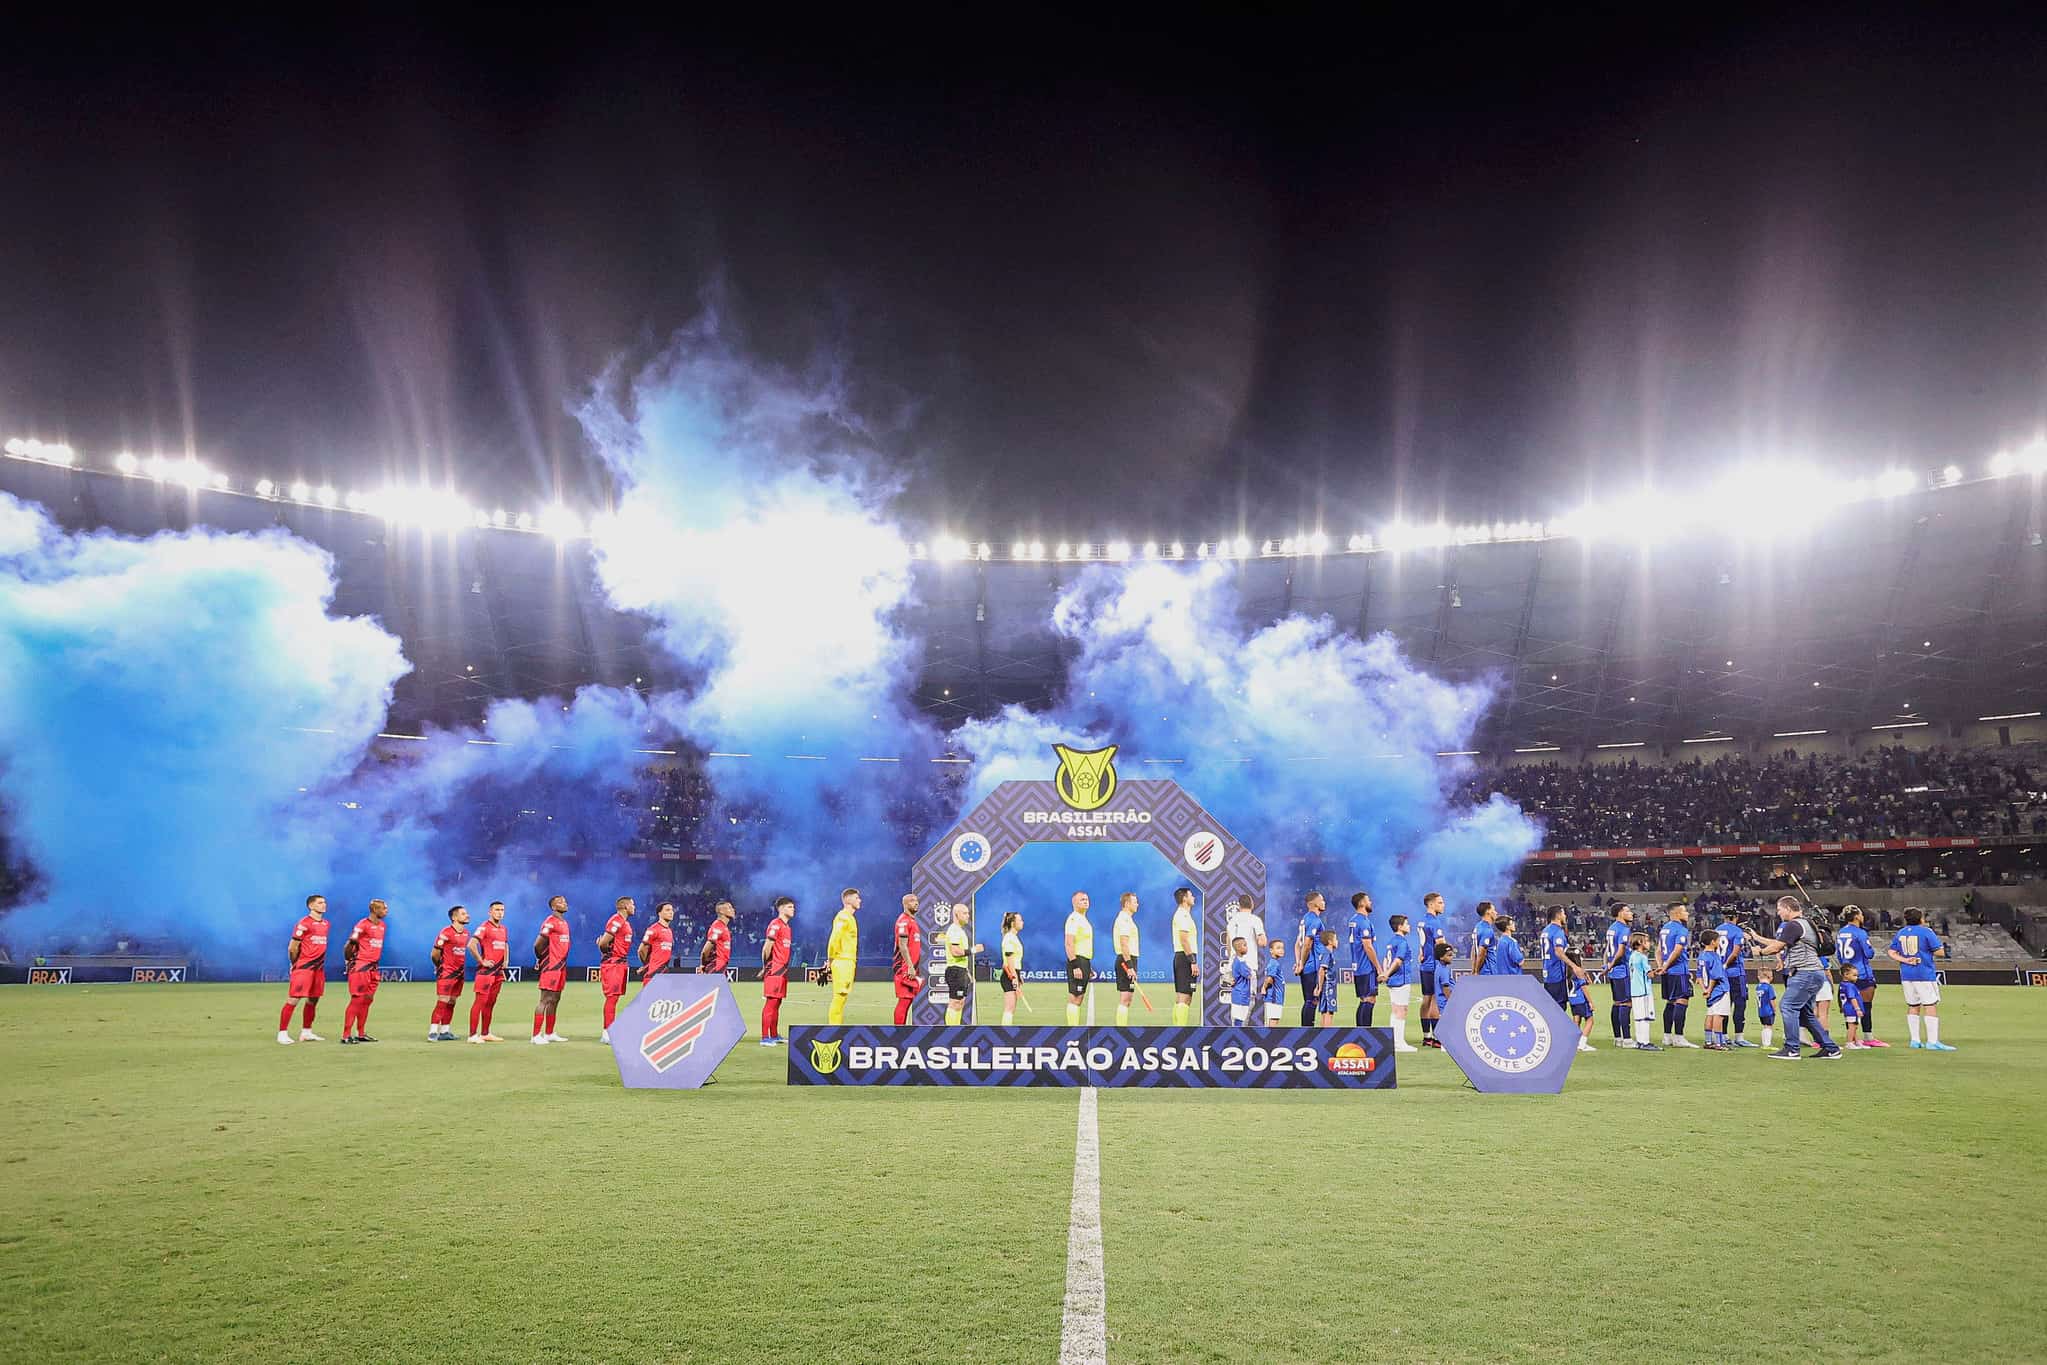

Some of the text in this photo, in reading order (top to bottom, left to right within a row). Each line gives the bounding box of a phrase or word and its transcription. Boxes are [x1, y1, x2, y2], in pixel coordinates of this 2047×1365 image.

[1023, 809, 1151, 824] BRASILEIRÃO
[1067, 825, 1107, 837] ASSAÍ
[1837, 938, 1855, 960] 16
[1898, 935, 1919, 956] 10
[31, 970, 67, 984] BRAX
[135, 970, 181, 982] BRAX
[381, 970, 408, 982] RAX
[1473, 1000, 1536, 1021] CRUZEIRO
[848, 1040, 1319, 1072] BRASILEIRÃO ASSAÍ 2023
[1470, 1027, 1520, 1069] ESPORTE
[1525, 1027, 1546, 1065] CLUBE
